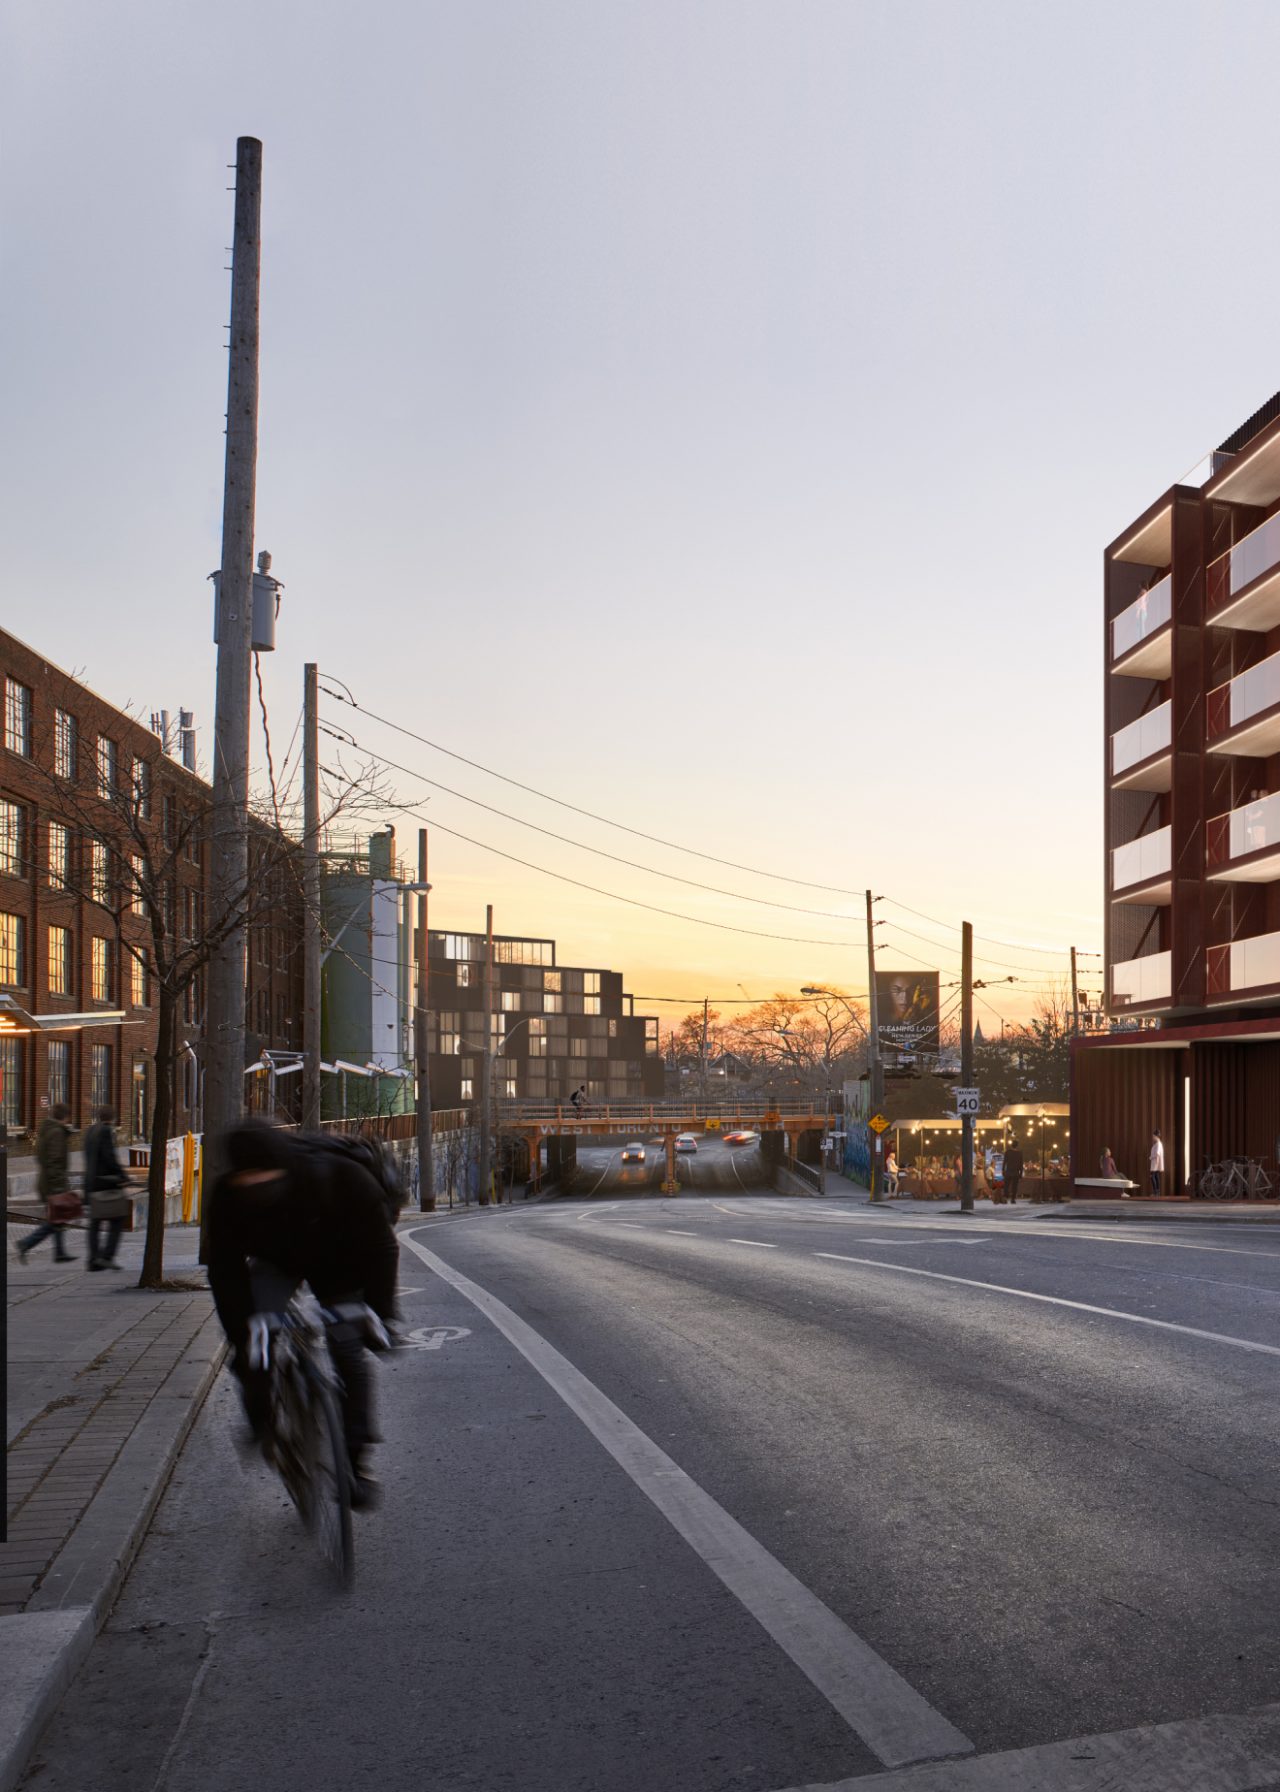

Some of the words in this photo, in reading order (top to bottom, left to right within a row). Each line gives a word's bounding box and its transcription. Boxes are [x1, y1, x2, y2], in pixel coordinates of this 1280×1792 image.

[958, 1098, 978, 1110] 40
[540, 1124, 592, 1135] WEST
[609, 1123, 682, 1134] TORONTO
[719, 1121, 785, 1132] ILPATH
